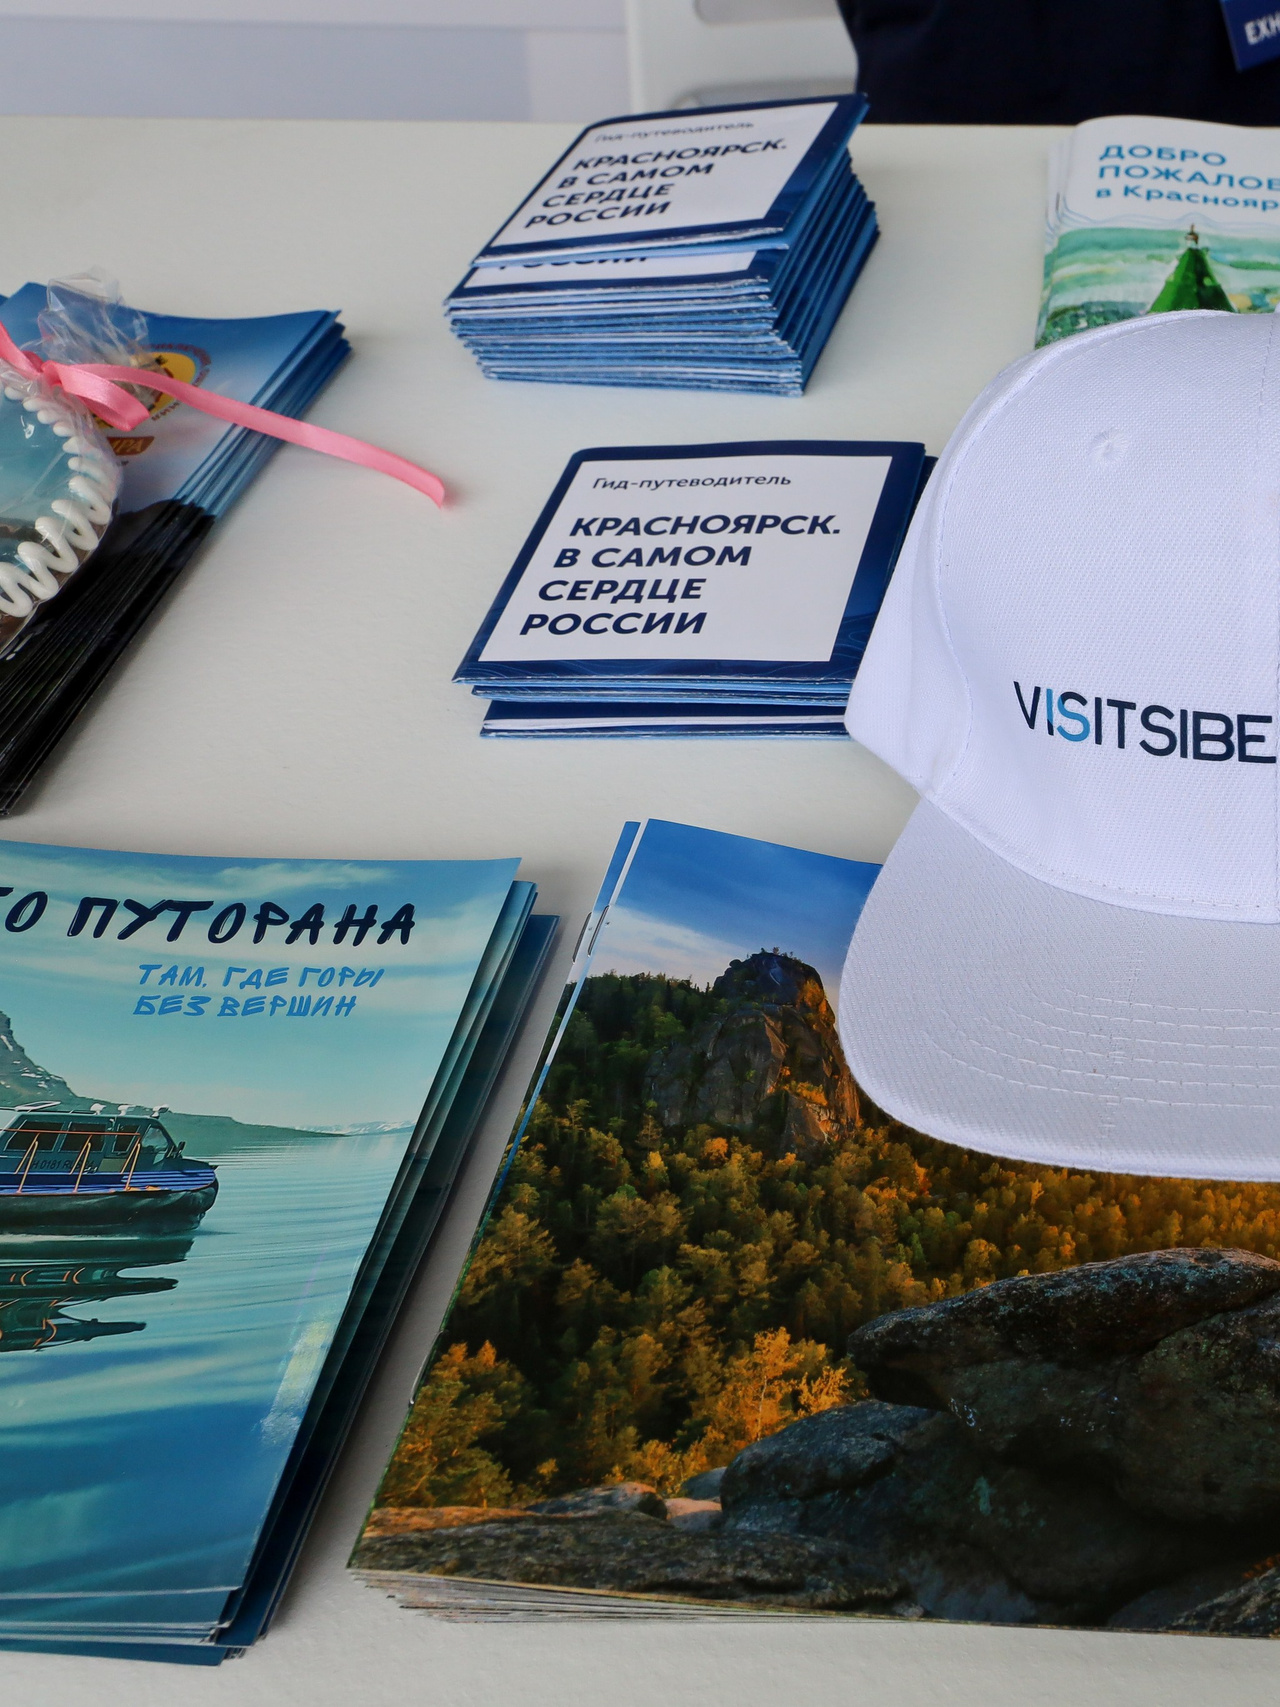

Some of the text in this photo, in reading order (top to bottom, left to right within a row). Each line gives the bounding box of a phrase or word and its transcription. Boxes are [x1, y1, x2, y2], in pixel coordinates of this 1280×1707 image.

[573, 138, 787, 171] КРАСНОЯРСК.
[1099, 144, 1227, 167] ДОБРО
[557, 163, 715, 189] В САМОМ
[542, 183, 675, 208] СЕРДЦЕ
[1096, 188, 1112, 199] в
[524, 201, 672, 229] РОССИИ
[593, 475, 792, 491] Гид-путеводитель
[569, 514, 841, 537] КРАСНОЯРСК.
[553, 546, 752, 568] В САМОМ
[538, 578, 707, 604] СЕРДЦЕ
[519, 612, 708, 636] РОССИИ
[67, 897, 416, 947] ПУТОРАНА
[222, 966, 290, 990] ГДЕ
[298, 966, 385, 988] ГОРЫ
[133, 995, 357, 1018] БЕЗ ВЕРШИН
